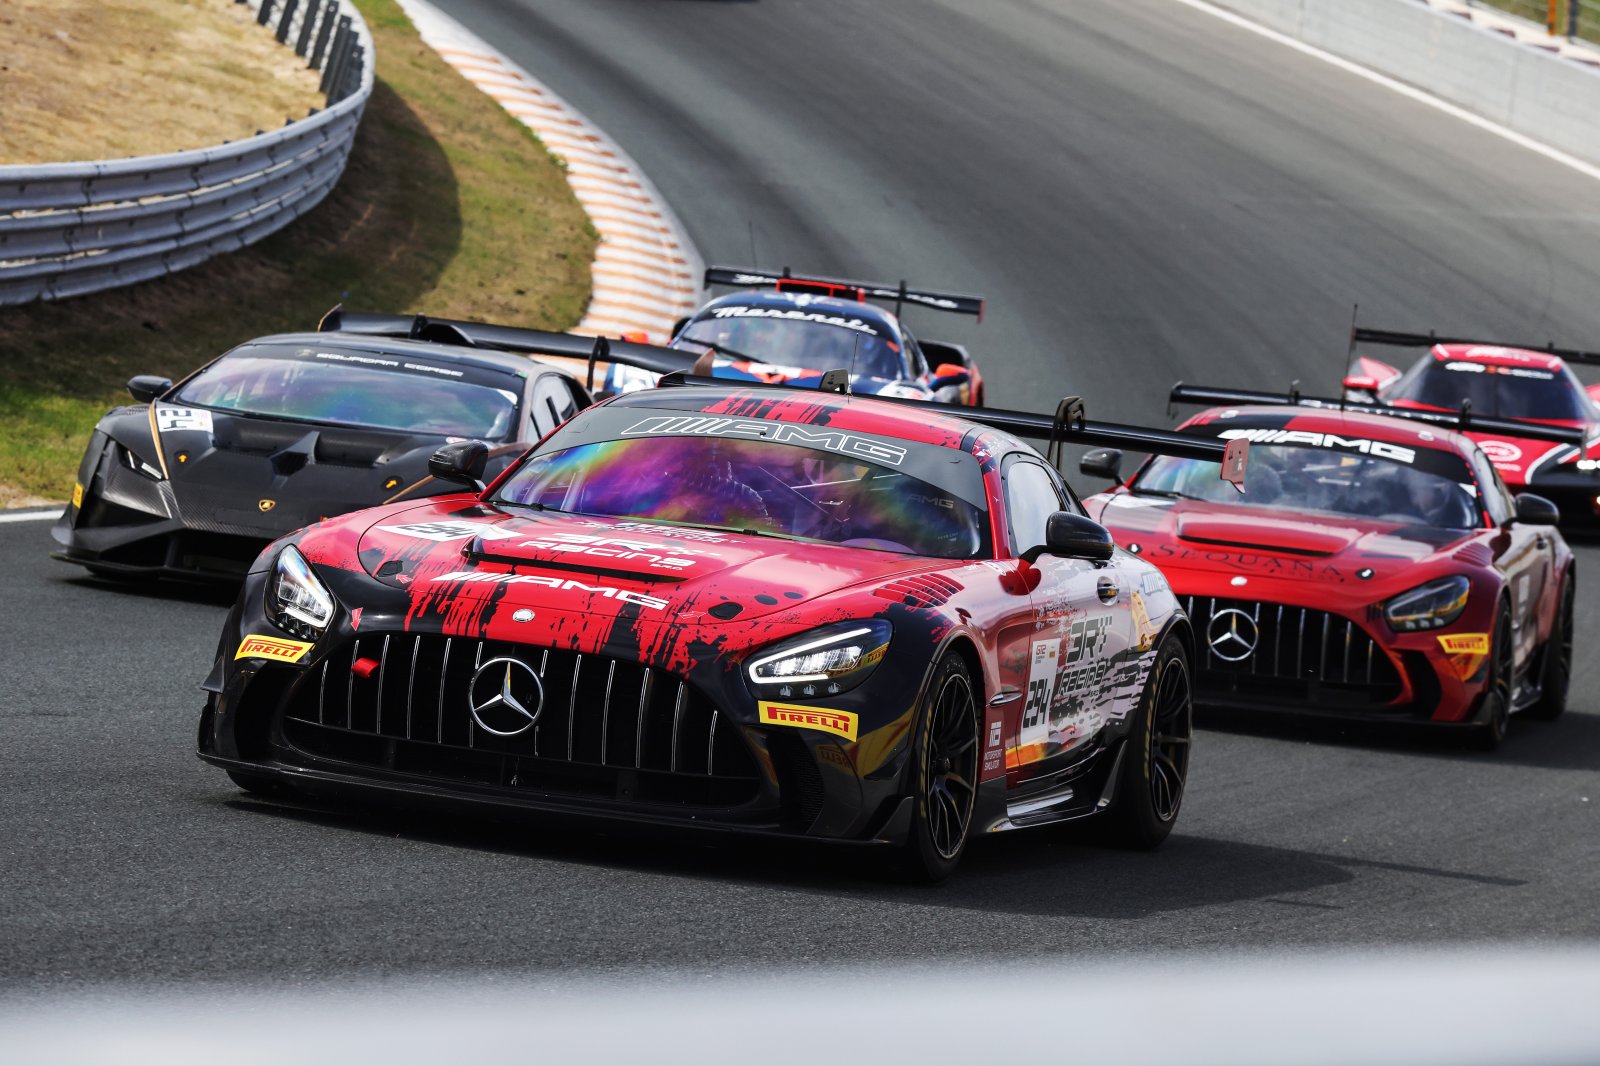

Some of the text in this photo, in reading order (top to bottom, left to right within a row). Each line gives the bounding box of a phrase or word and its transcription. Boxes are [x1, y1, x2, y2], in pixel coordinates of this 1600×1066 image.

[1280, 431, 1416, 464] AMG
[241, 639, 303, 658] PIRELLI
[1023, 678, 1050, 728] 294
[767, 706, 850, 733] PIRELLI
